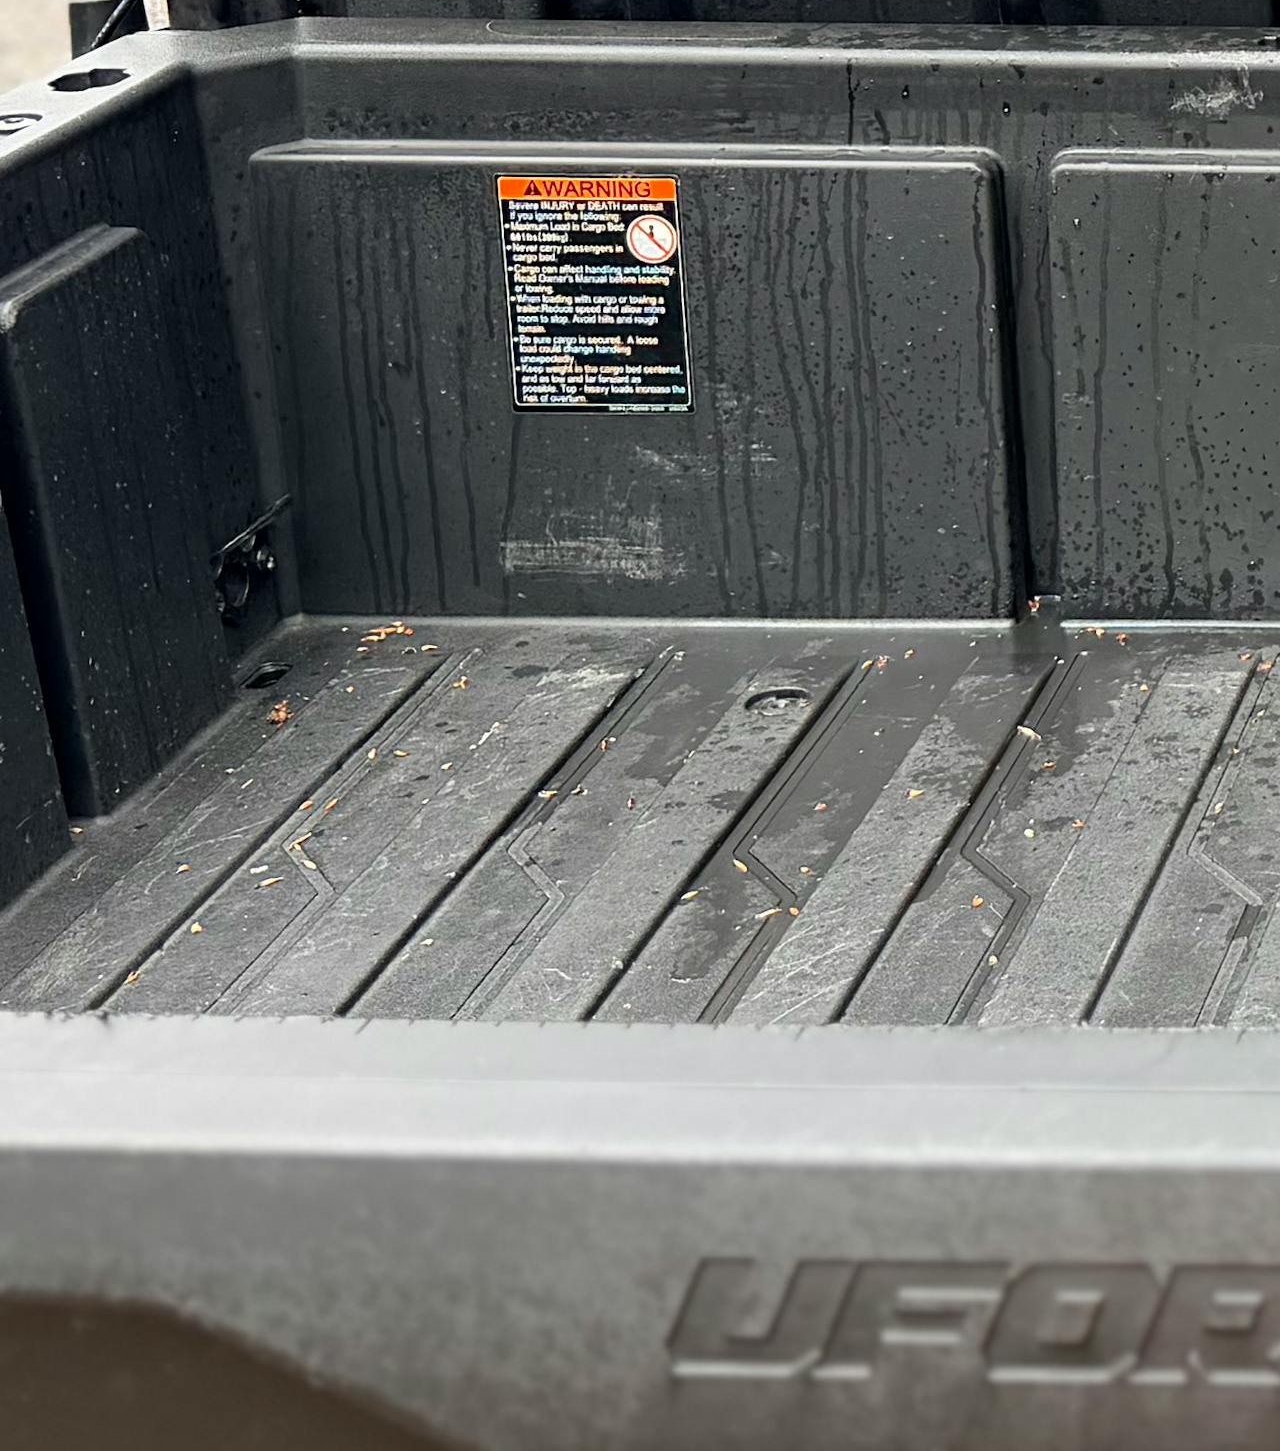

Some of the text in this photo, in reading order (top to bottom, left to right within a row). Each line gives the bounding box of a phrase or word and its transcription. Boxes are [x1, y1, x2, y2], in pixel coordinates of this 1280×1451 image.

[543, 180, 650, 197] WARNING
[588, 202, 620, 211] DEATH
[517, 212, 533, 222] you
[535, 212, 562, 222] ignore
[550, 223, 570, 232] Load
[581, 223, 605, 233] Cargo
[512, 244, 538, 253] Never
[539, 244, 561, 254] carry
[563, 245, 613, 254] passengers
[513, 254, 537, 263] cargo
[513, 265, 540, 275] Cargo
[541, 265, 557, 273] can
[559, 265, 583, 273] affect
[585, 266, 622, 275] handling
[623, 266, 640, 274] and
[575, 275, 608, 283] Manual
[609, 275, 637, 284] before
[542, 295, 573, 305] loading
[574, 295, 591, 304] with
[593, 295, 616, 305] cargo
[629, 295, 657, 305] towing
[575, 305, 601, 315] speed
[603, 306, 619, 314] and
[621, 306, 642, 314] allow
[517, 315, 538, 324] room
[572, 315, 596, 324] Avoid
[616, 316, 632, 324] and
[634, 316, 658, 325] rough
[553, 336, 577, 346] cargo
[636, 336, 658, 344] loose
[538, 345, 562, 354] could
[563, 345, 594, 355] change
[596, 345, 631, 355] handling
[521, 365, 544, 375] Keep
[584, 365, 598, 374] the
[599, 365, 624, 375] cargo
[625, 365, 641, 374] bed
[521, 375, 537, 383] and
[567, 375, 584, 383] and
[561, 385, 577, 395] Top
[584, 385, 609, 395] heavy
[611, 385, 634, 394] loads
[672, 385, 686, 394] the
